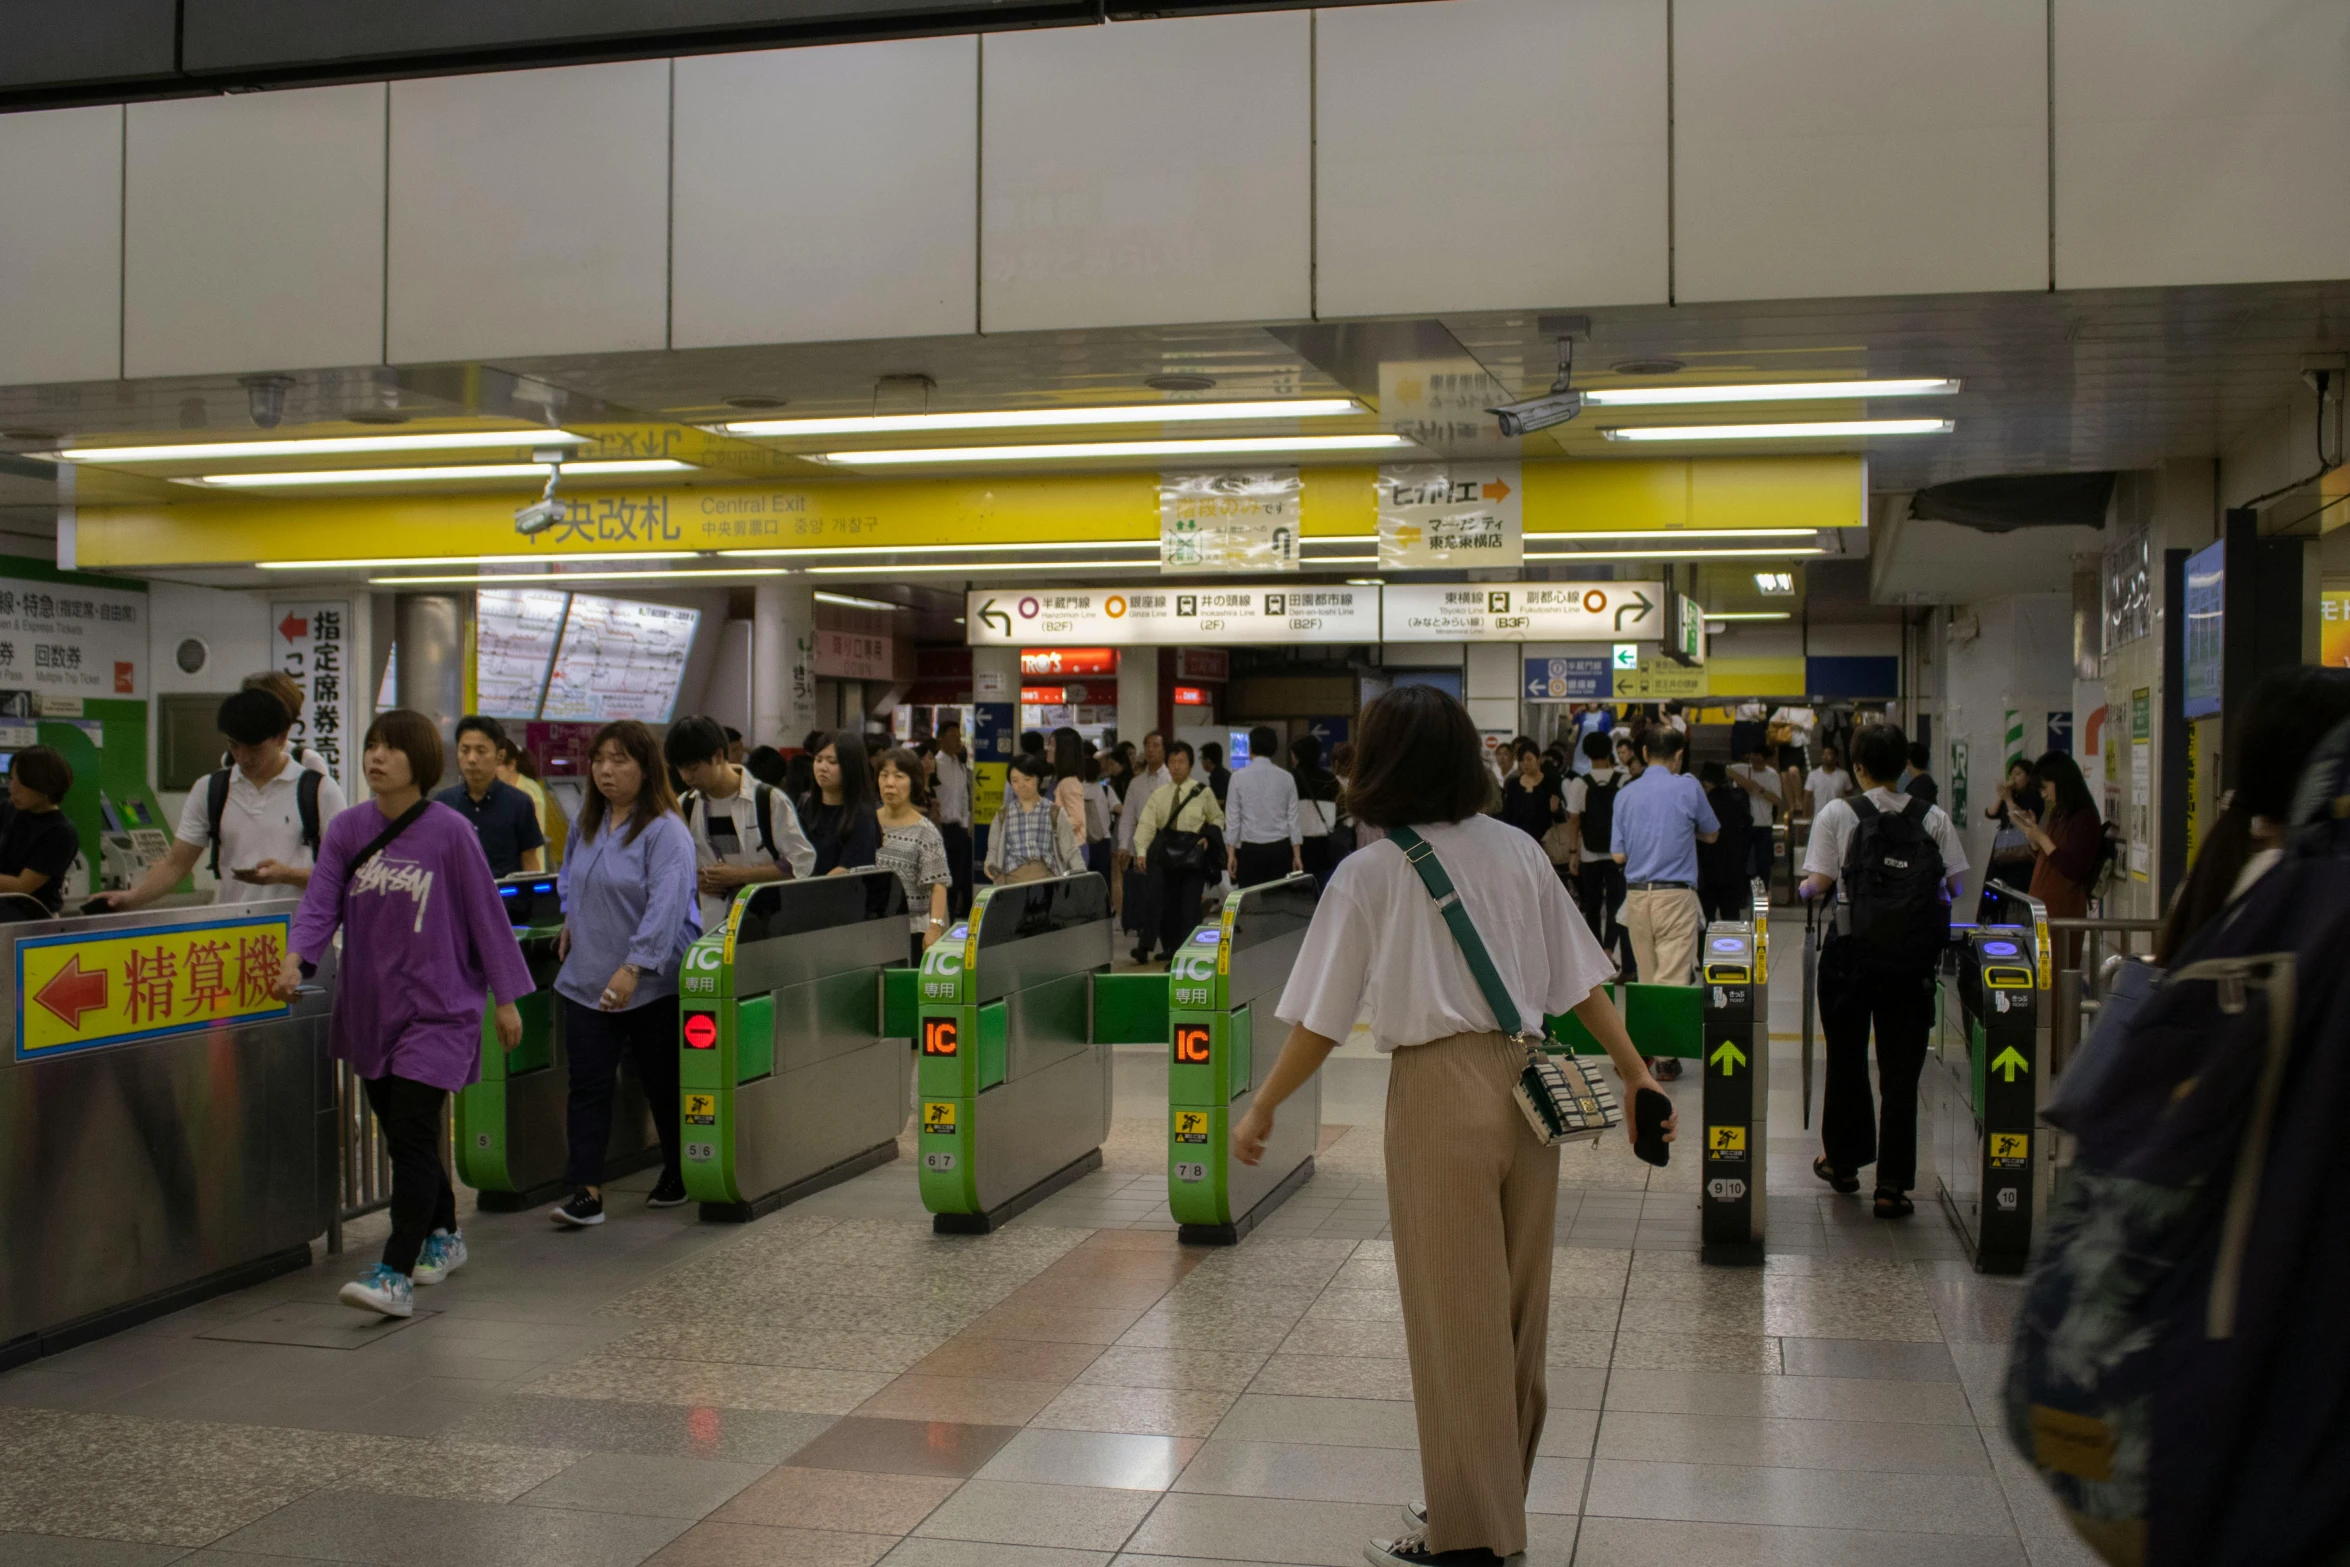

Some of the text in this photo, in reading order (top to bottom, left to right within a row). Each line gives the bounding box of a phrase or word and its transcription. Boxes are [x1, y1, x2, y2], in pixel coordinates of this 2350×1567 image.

[701, 494, 805, 515] Central Exit
[702, 519, 778, 537] 中央剪票口
[1429, 533, 1503, 550] 東急東横店
[1042, 596, 1091, 609] 半蔵門線
[1129, 596, 1167, 608] 銀座線
[1201, 595, 1251, 607] 井の頭線
[1289, 593, 1353, 606] 田園都市線
[1444, 591, 1484, 605] 東横線
[1526, 591, 1580, 604] 副都心線
[1081, 610, 1096, 618] Line
[1129, 610, 1150, 618] Ginza
[1201, 609, 1238, 617] Inokashira
[1468, 606, 1484, 614] Line
[22, 621, 54, 633] Express
[56, 623, 83, 635] Tickets
[1041, 621, 1073, 632] (B2F)
[1200, 620, 1225, 631] (2F)
[1289, 618, 1323, 630] (B2F)
[1408, 616, 1484, 628] (みなとみらい線)
[1494, 617, 1530, 628] (B3F)
[35, 643, 82, 669] 回数券
[685, 946, 723, 970] IC
[924, 952, 963, 976] IC
[1175, 957, 1215, 981] IC
[123, 934, 282, 1025] 精算機
[685, 976, 714, 993] 専用
[924, 982, 954, 999] 専用
[1175, 988, 1207, 1004] 専用
[1729, 990, 1745, 998] きっぷ
[2012, 995, 2028, 1003] きっぷ
[926, 1023, 957, 1053] IC
[1178, 1030, 1209, 1060] IC
[479, 1135, 487, 1146] 5
[689, 1145, 711, 1156] 5 6
[928, 1156, 951, 1166] 6 7
[1180, 1165, 1202, 1176] 7 8
[1714, 1183, 1742, 1194] 9 10
[2002, 1192, 2015, 1203] 10
